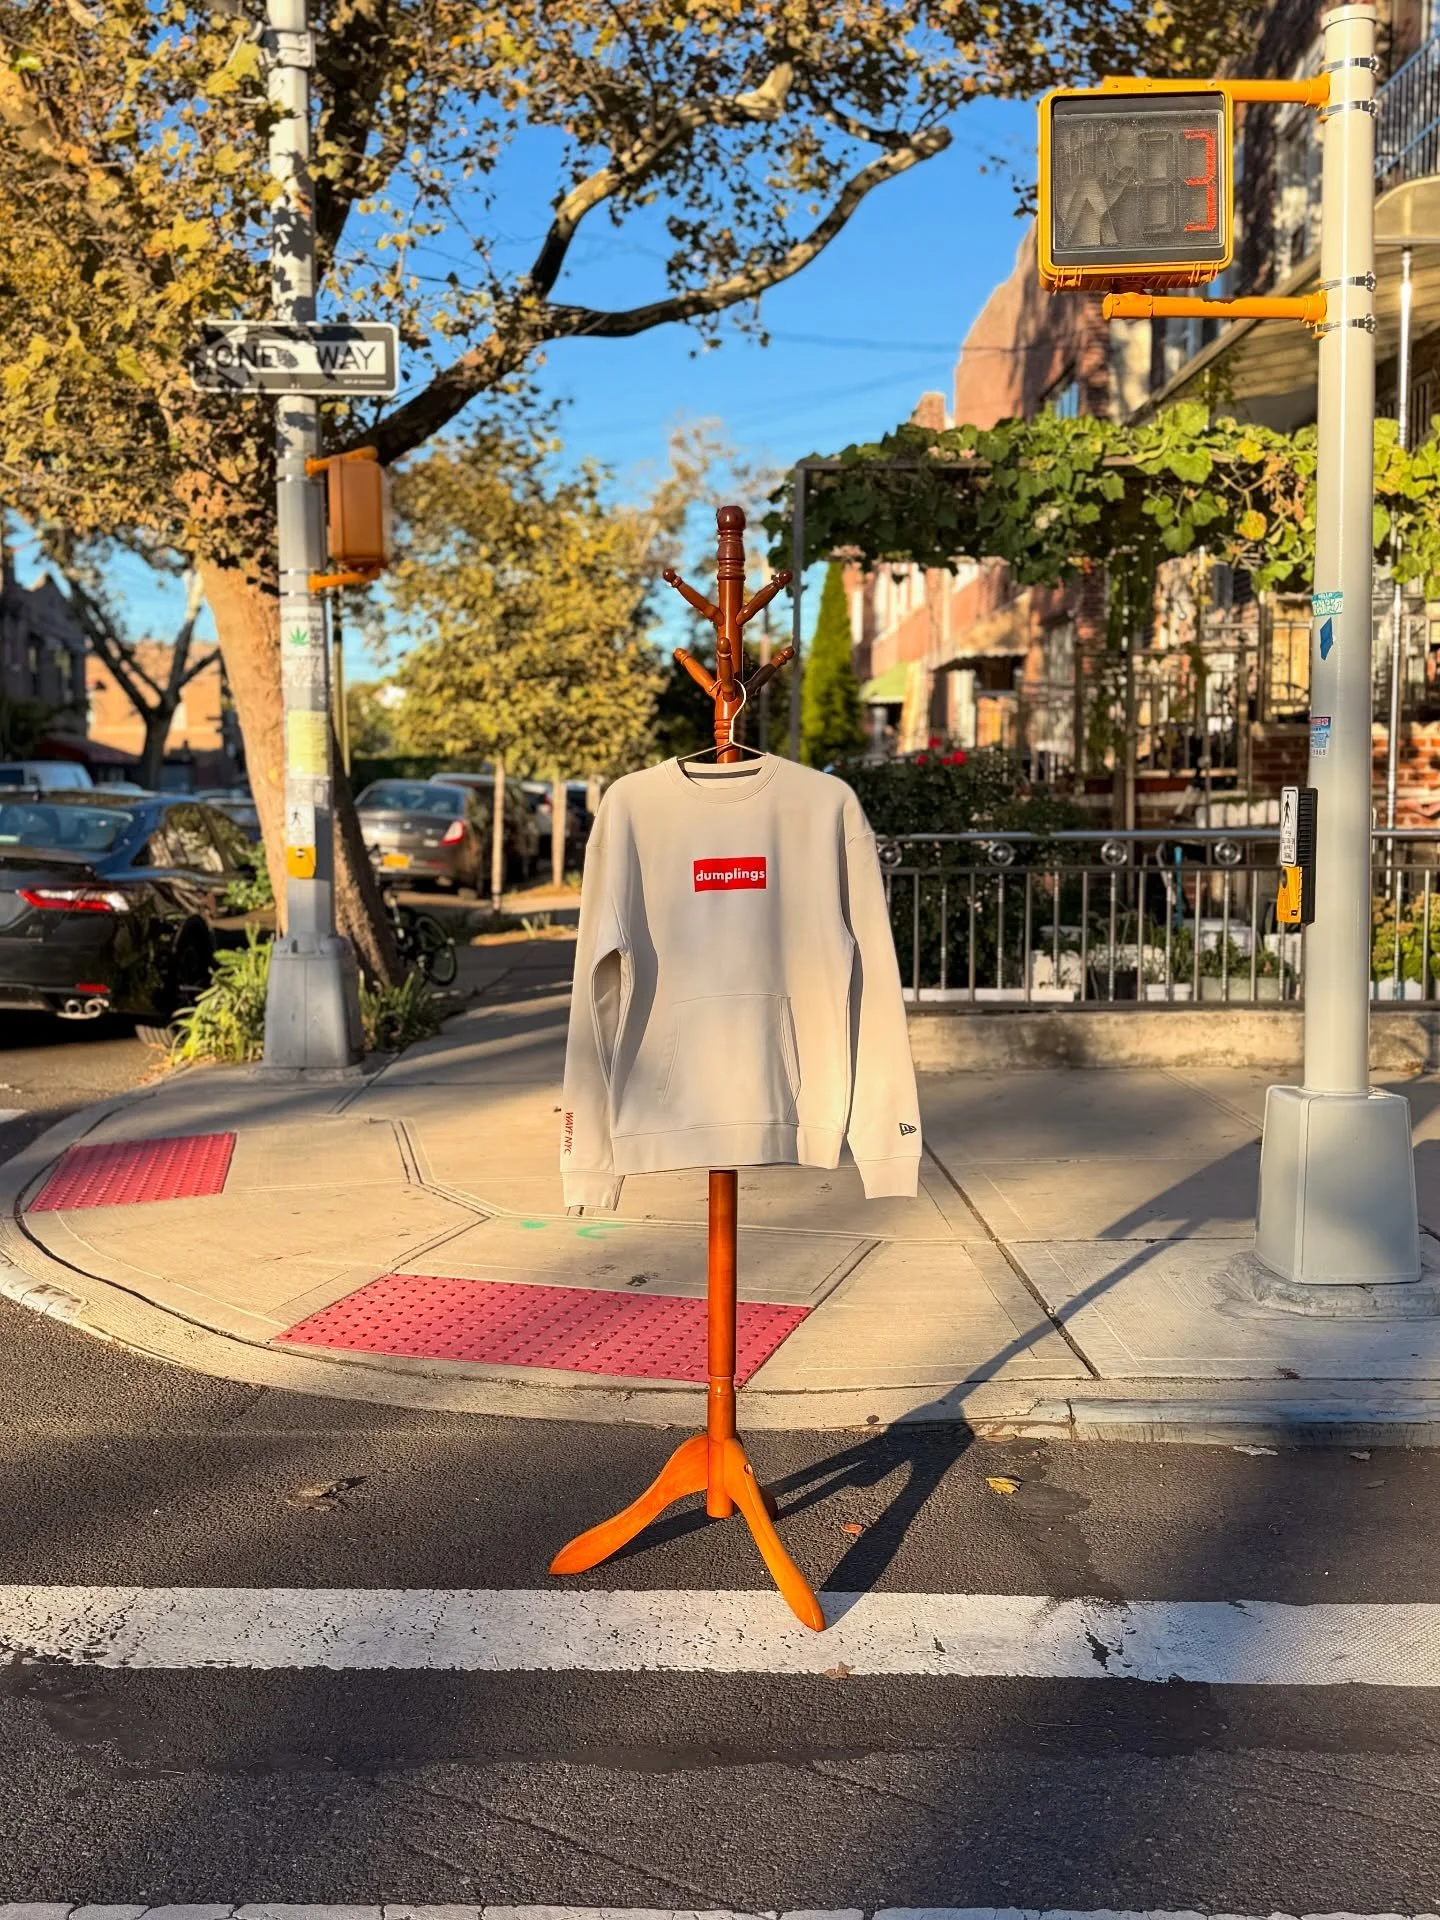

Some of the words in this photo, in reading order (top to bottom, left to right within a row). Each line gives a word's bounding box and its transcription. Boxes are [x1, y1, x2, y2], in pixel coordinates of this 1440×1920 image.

[1184, 129, 1217, 232] 3
[215, 344, 275, 368] ONE
[316, 345, 376, 370] WAY
[696, 868, 765, 883] dumplings
[564, 1136, 573, 1156] NYC
